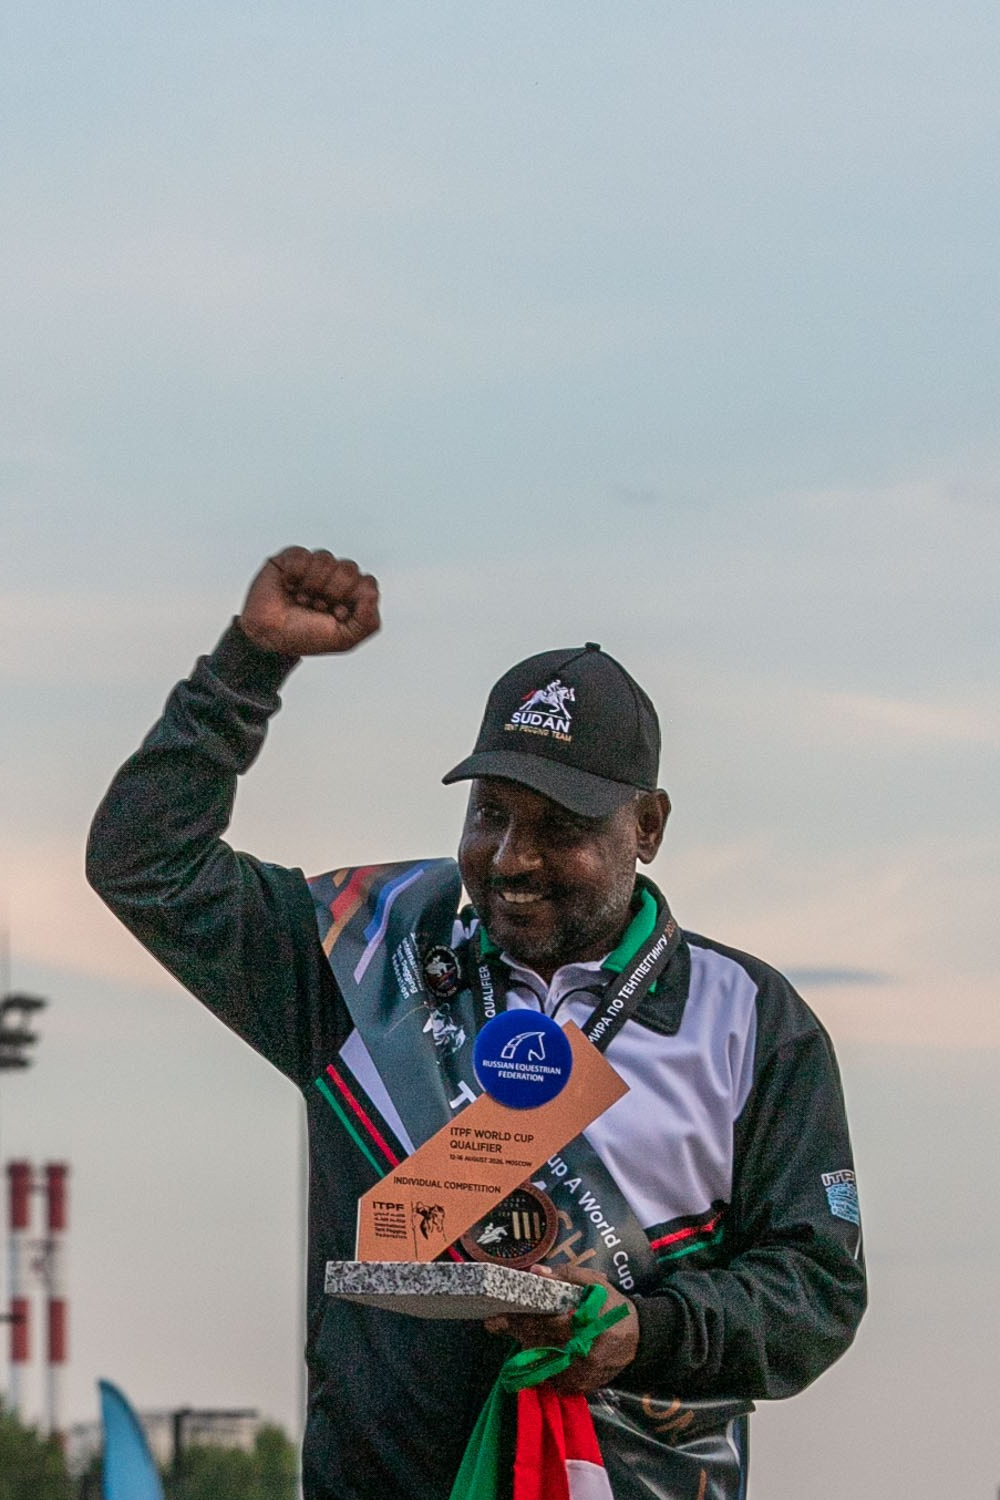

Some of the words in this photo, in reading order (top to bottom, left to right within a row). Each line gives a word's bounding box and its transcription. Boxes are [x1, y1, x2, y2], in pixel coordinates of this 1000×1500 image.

[511, 712, 570, 733] SUDAN
[551, 731, 573, 742] TEAM
[607, 999, 624, 1016] ПО
[618, 934, 668, 998] ТЕНТПЕГГИНГУ
[479, 964, 496, 1018] QUALIFIER
[482, 1060, 514, 1070] RUSSIAN
[515, 1063, 561, 1075] EQUESTRIAN
[498, 1071, 544, 1082] FEDERATION
[450, 1127, 472, 1137] ITPF
[474, 1130, 511, 1141] WORLD
[514, 1133, 534, 1143] CUP
[450, 1140, 502, 1153] QUALIFIER
[464, 1155, 487, 1163] AUGUST
[505, 1159, 532, 1167] MOSCOW
[393, 1176, 442, 1188] INDIVIDUAL
[444, 1181, 501, 1193] COMPETITION
[821, 1169, 855, 1187] ITP
[373, 1201, 404, 1211] ITPF
[547, 1154, 568, 1177] up
[563, 1177, 582, 1194] A
[578, 1191, 622, 1248] World
[613, 1251, 635, 1290] Cup
